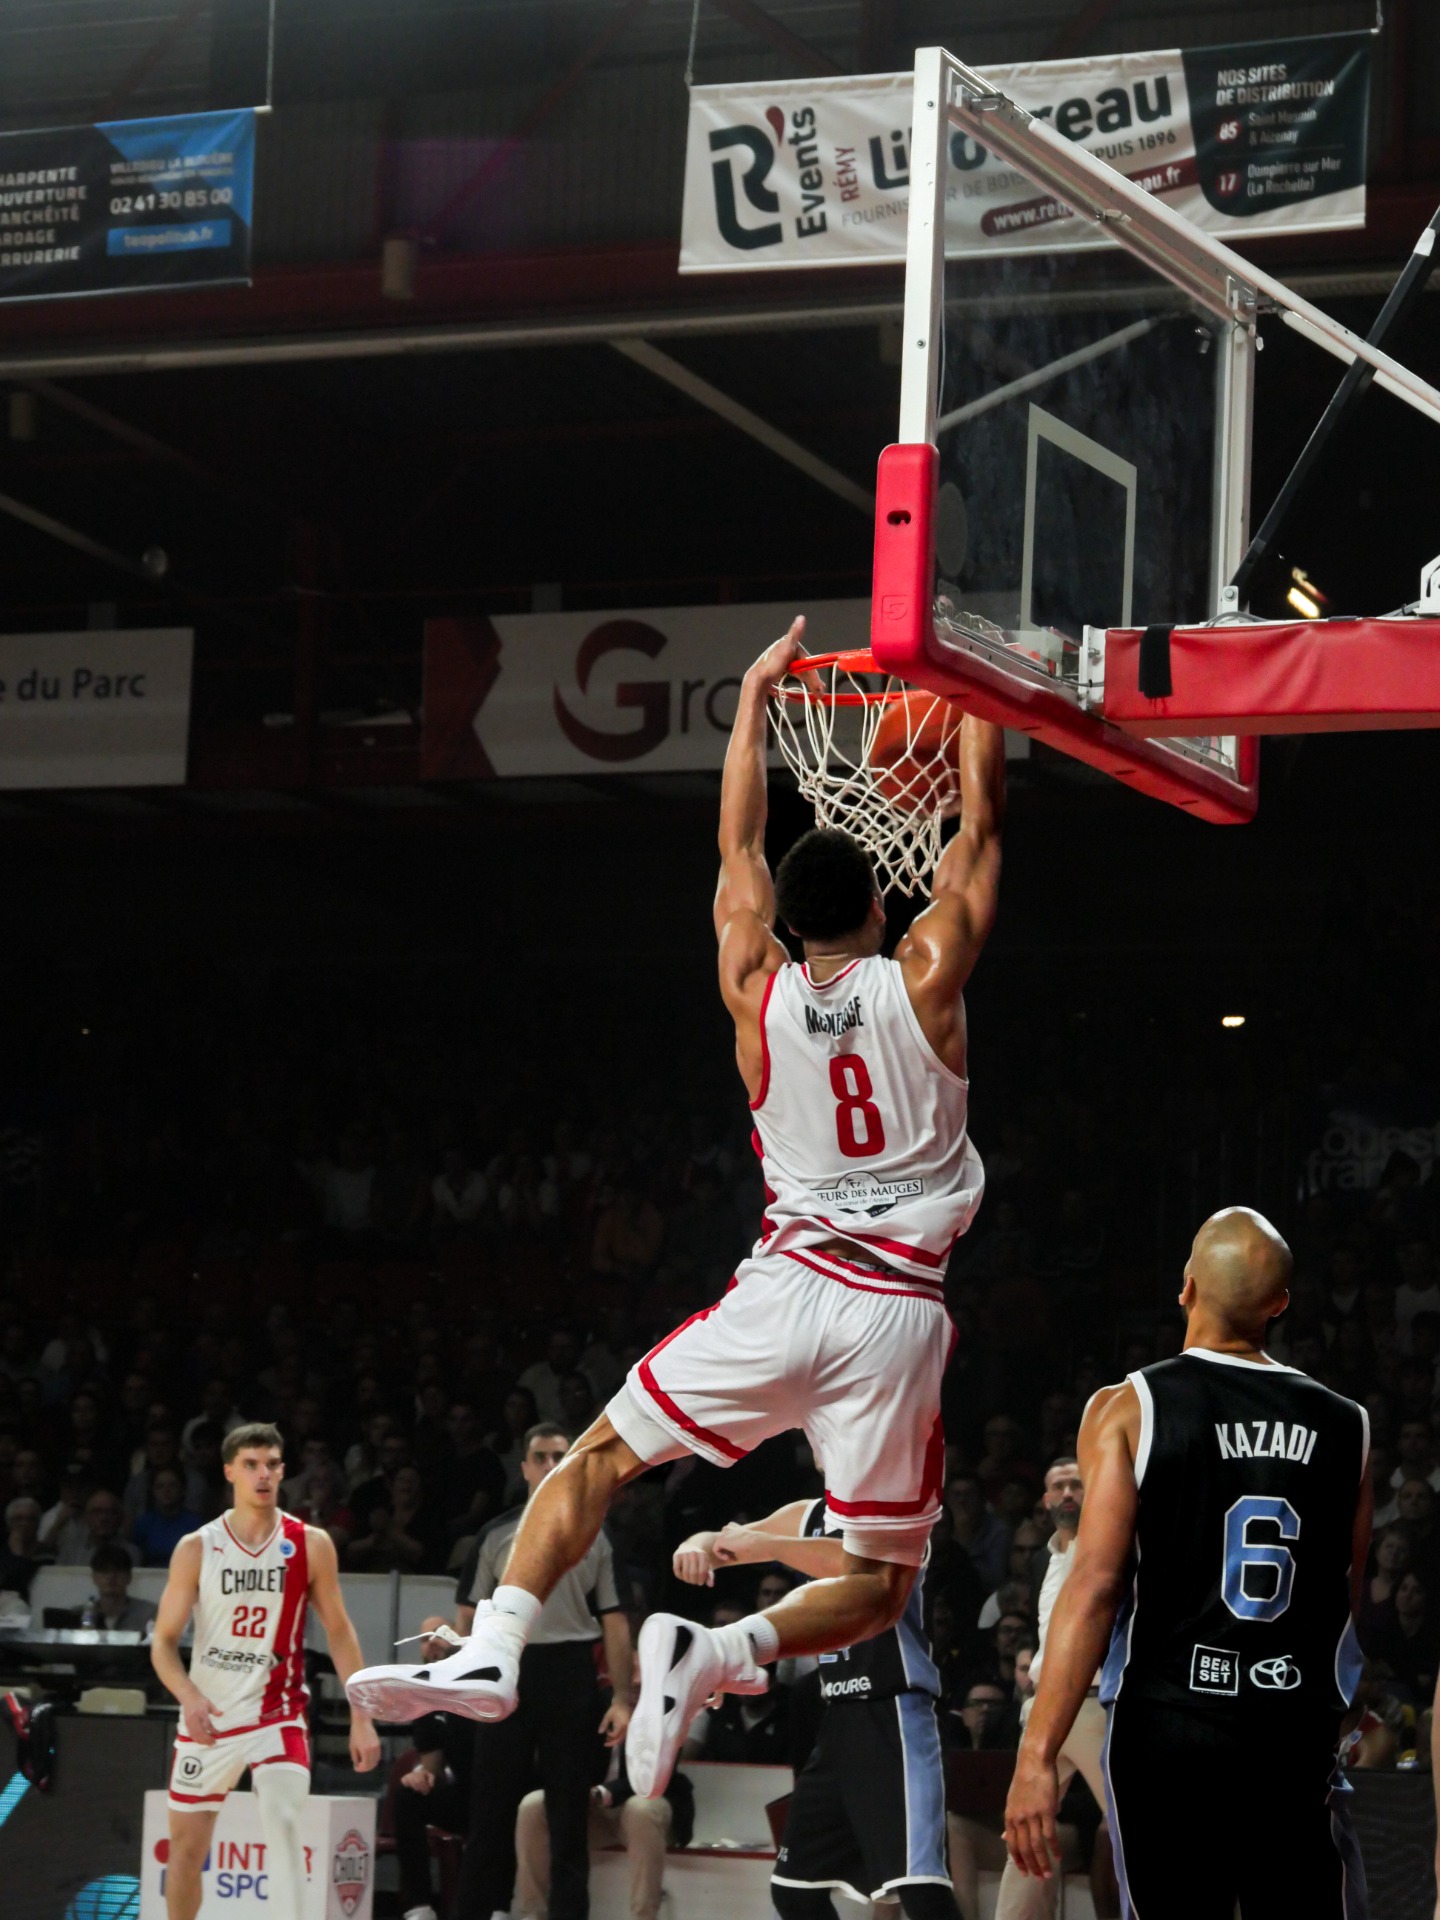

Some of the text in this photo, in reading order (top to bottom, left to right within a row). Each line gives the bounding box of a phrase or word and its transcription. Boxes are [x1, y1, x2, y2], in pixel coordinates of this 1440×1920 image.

[1217, 64, 1287, 86] NOS SITES
[1215, 80, 1335, 106] DE DISTRIBUTION
[1090, 140, 1134, 160] PUIS
[1138, 128, 1177, 151] 1896
[788, 106, 828, 239] Events
[834, 147, 861, 203] RÉMY
[0, 185, 87, 207] UVERTURE
[110, 196, 131, 215] 02
[134, 194, 155, 212] 41
[158, 192, 182, 210] 30
[211, 187, 234, 206] 00
[0, 228, 56, 247] RDAGE
[16, 669, 61, 702] du
[72, 666, 147, 700] Parc
[829, 1053, 886, 1158] 8
[851, 1188, 868, 1199] DES
[870, 1180, 920, 1197] MAUGES
[1214, 1421, 1318, 1465] KAZADI
[1221, 1495, 1301, 1622] 6
[221, 1566, 288, 1596] CHOLET
[231, 1605, 268, 1639] 22
[1199, 1669, 1231, 1684] SET
[1200, 1655, 1230, 1673] BER
